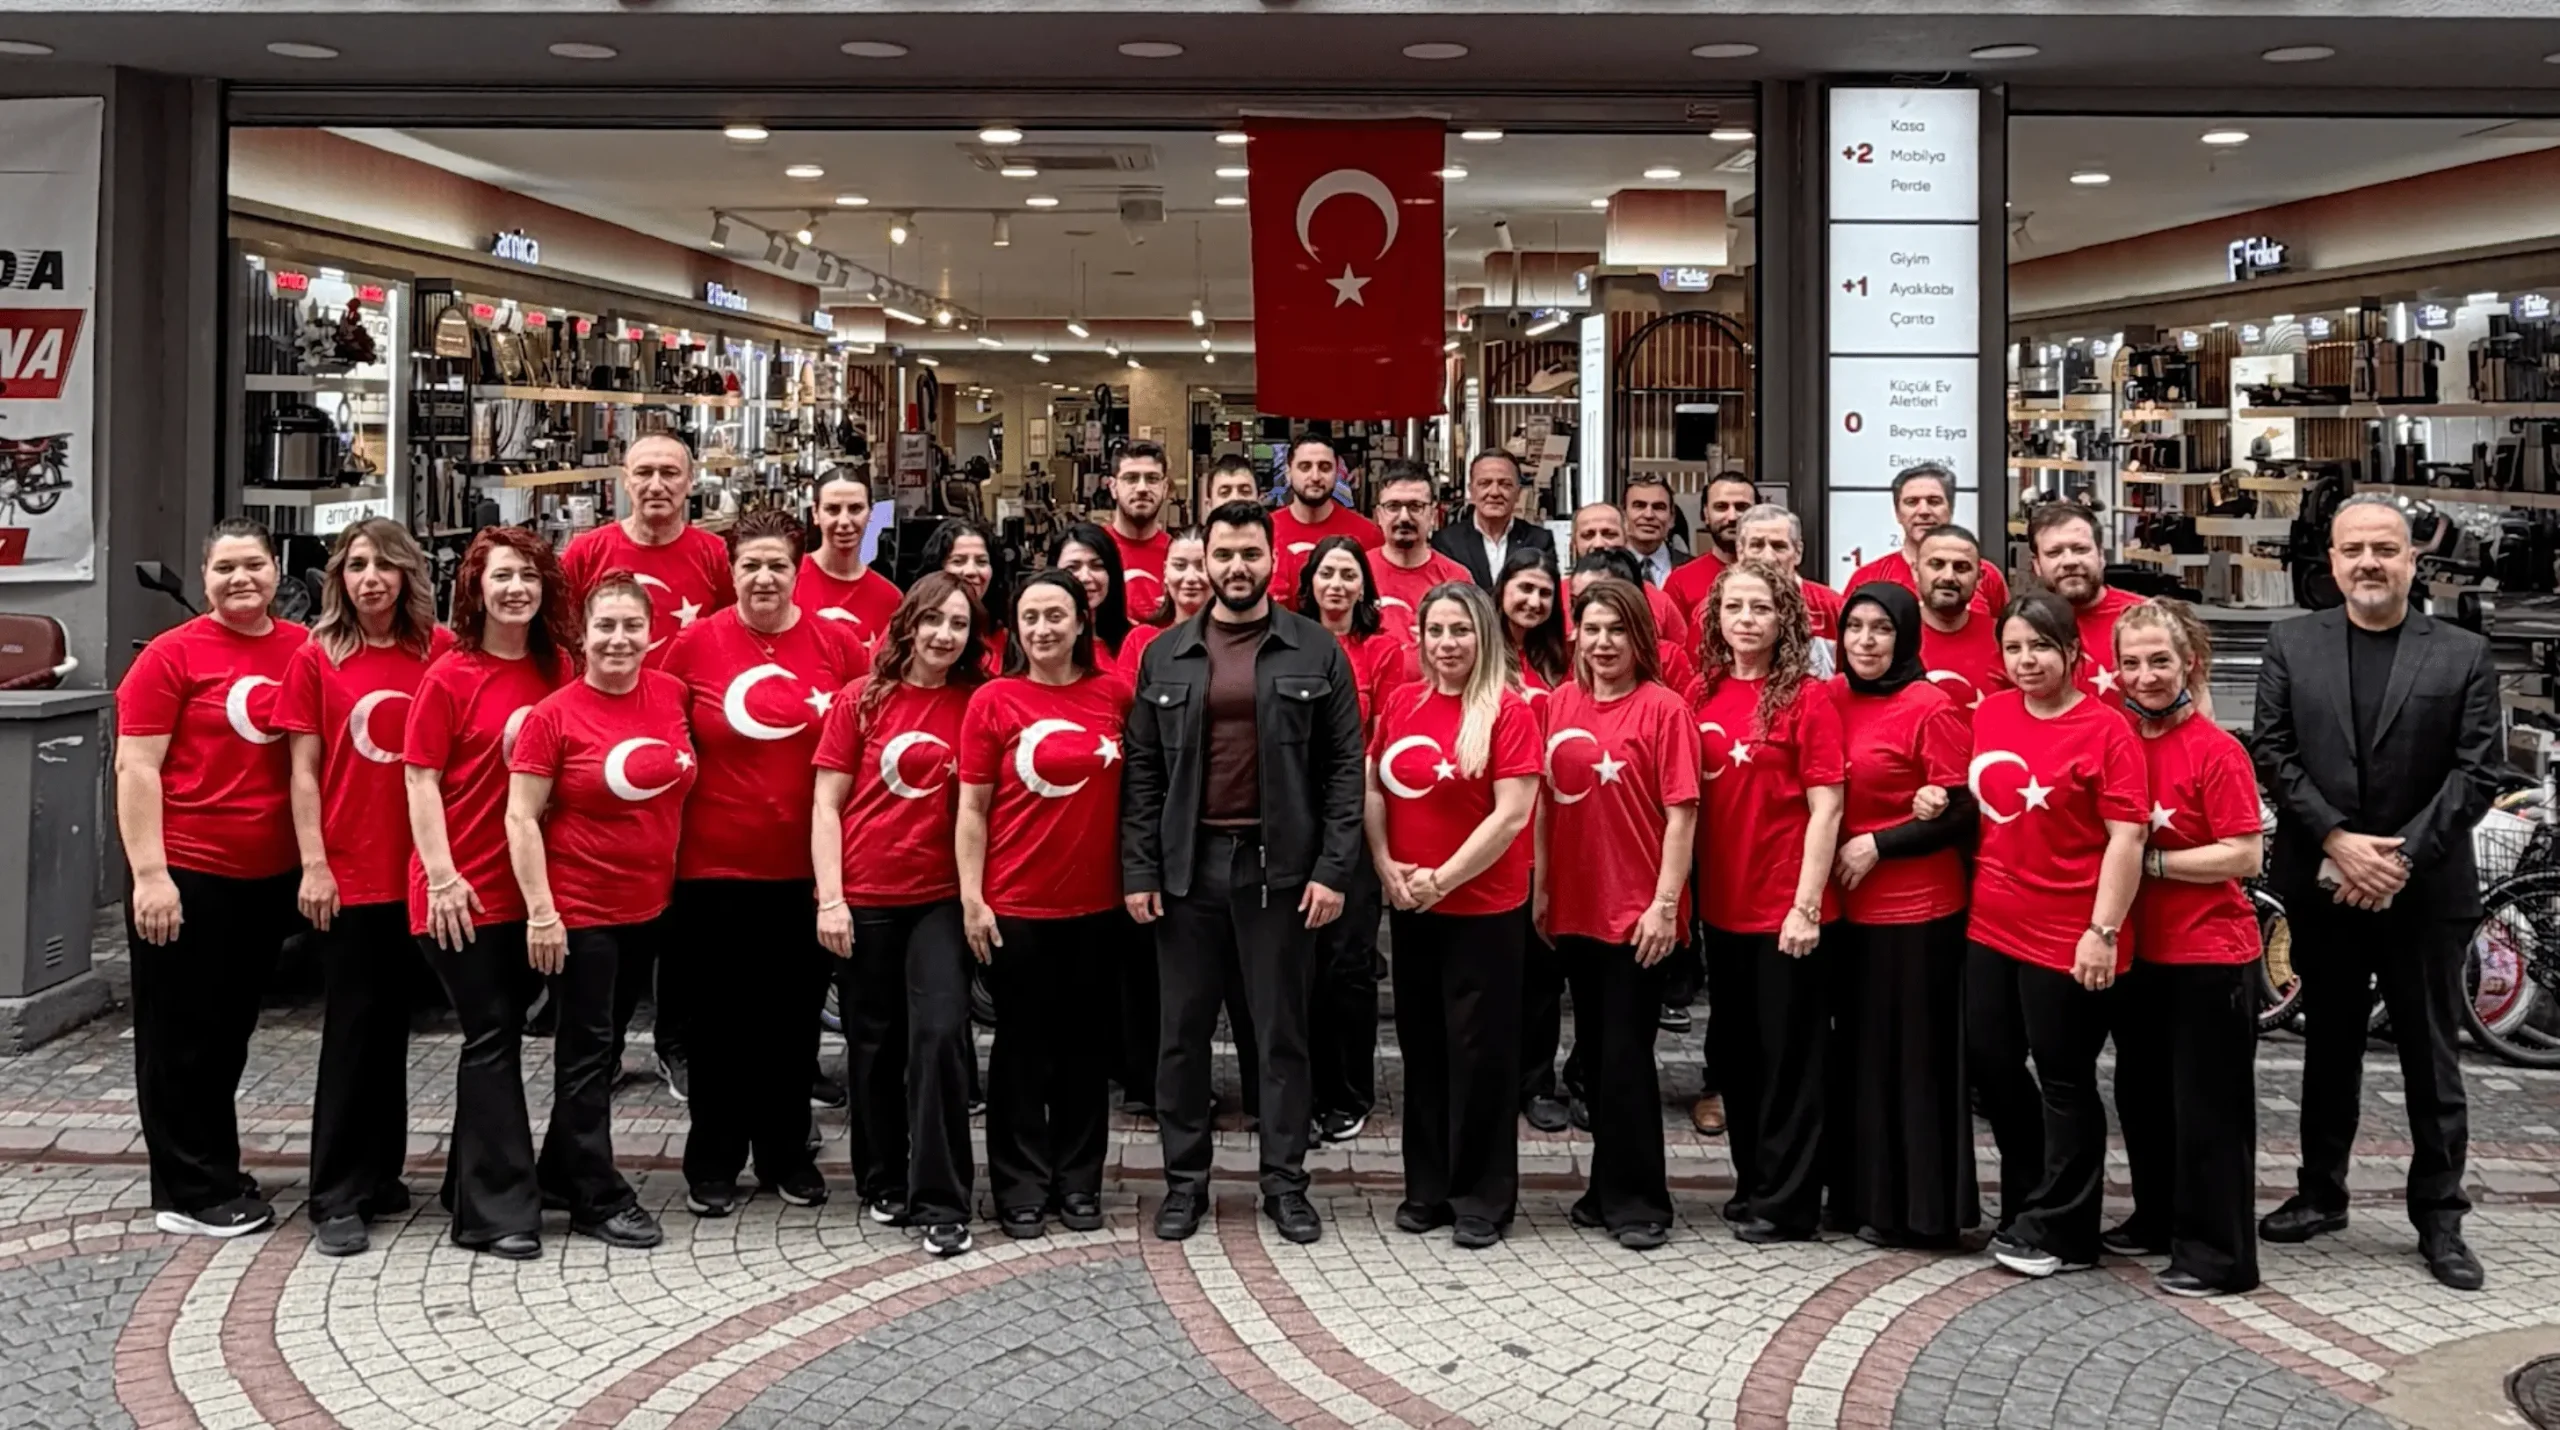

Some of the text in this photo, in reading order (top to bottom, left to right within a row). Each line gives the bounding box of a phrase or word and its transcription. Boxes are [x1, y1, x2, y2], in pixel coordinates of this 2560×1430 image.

[1890, 119, 1926, 133] Kasa
[1841, 142, 1874, 165] +2
[1890, 149, 1946, 165] Mobilya
[1890, 178, 1931, 193] Perde
[496, 229, 540, 265] arnica
[1889, 251, 1930, 268] Giyim
[1841, 275, 1869, 297] +1
[1889, 282, 1954, 298] Ayakkabı
[1889, 312, 1935, 328] Çanta
[1889, 379, 1952, 394] Küçük Ev
[1889, 395, 1938, 408] Aletleri
[1843, 411, 1863, 433] 0
[1889, 424, 1967, 441] Beyaz Eşya
[1841, 546, 1862, 567] -1
